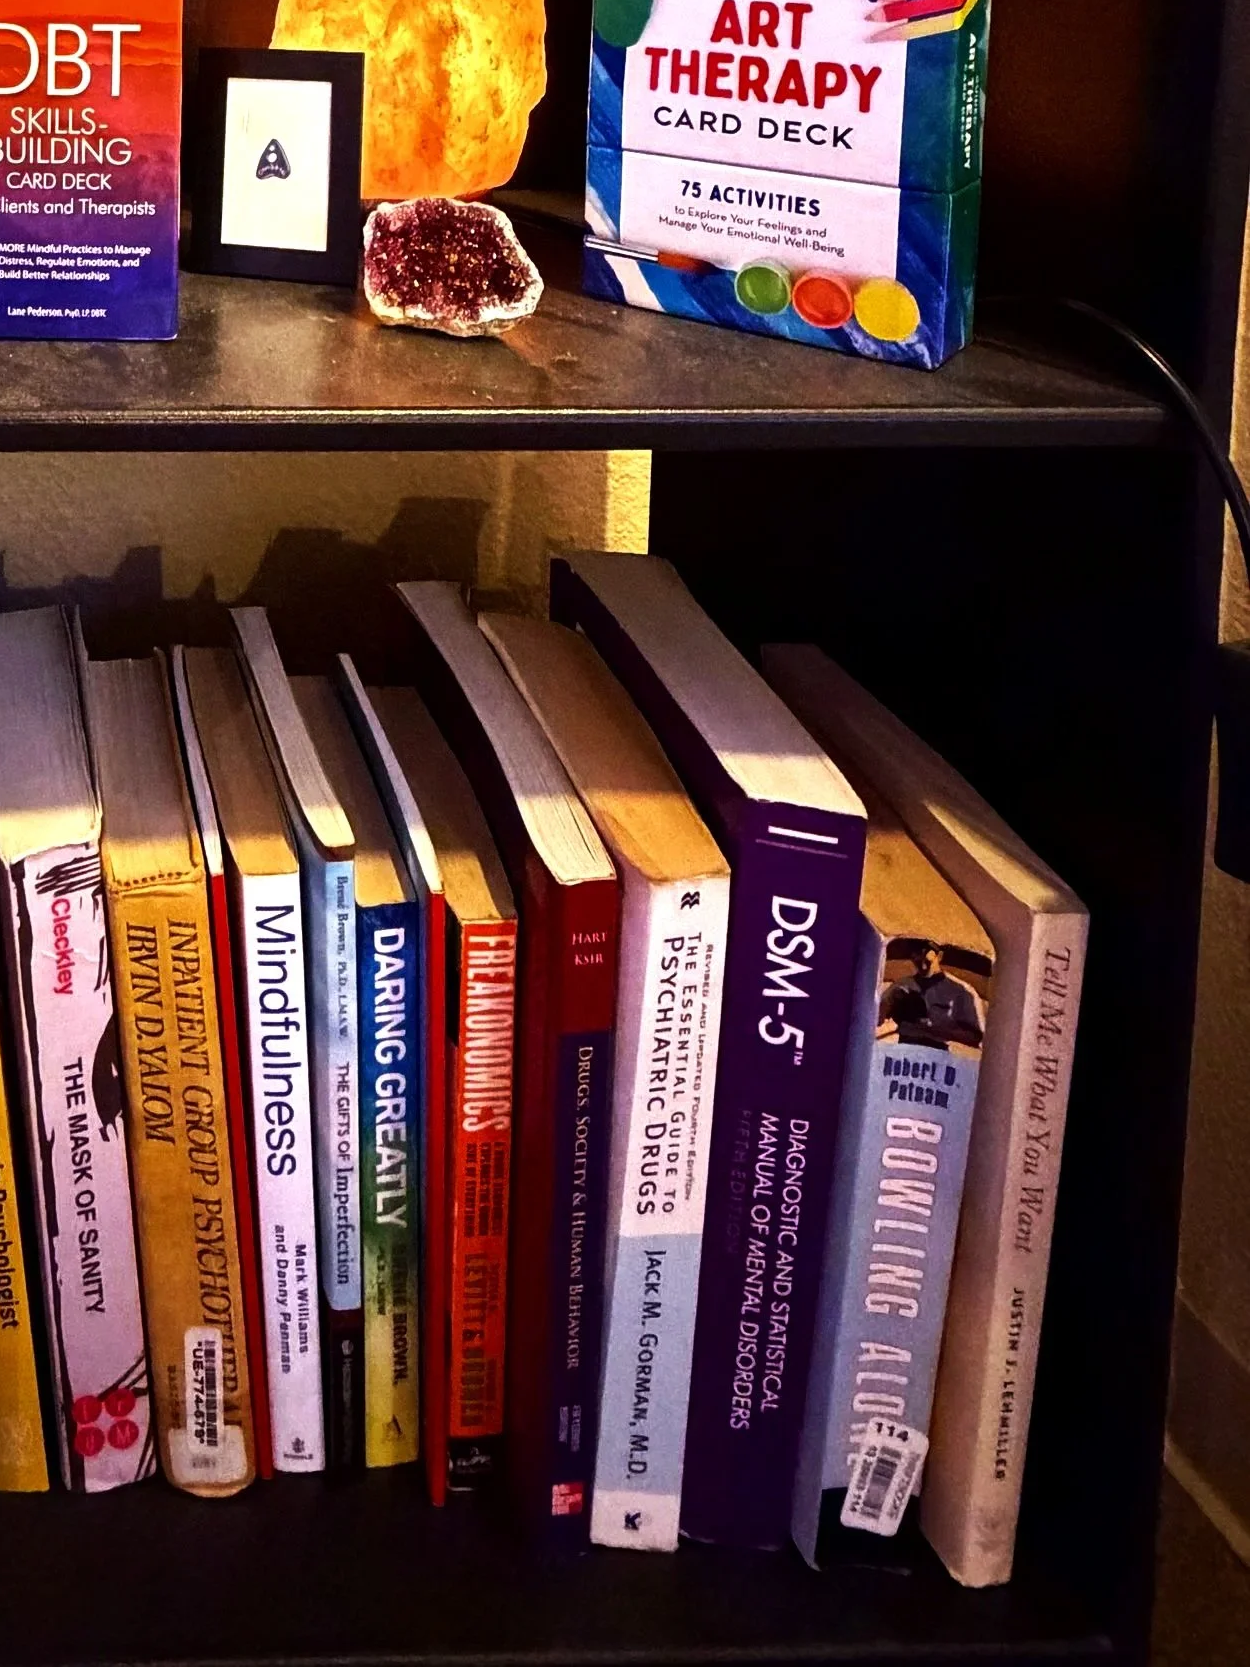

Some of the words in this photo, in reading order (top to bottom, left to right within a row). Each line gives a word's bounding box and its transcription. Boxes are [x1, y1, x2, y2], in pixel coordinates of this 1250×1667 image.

[710, 0, 814, 50] ART
[645, 47, 883, 113] THERAPY
[10, 107, 108, 135] SKILLS-
[654, 106, 742, 135] CARD
[757, 117, 854, 150] DECK
[963, 75, 975, 170] THERAPY
[6, 172, 57, 190] CARD
[62, 173, 112, 190] DECK
[43, 198, 74, 215] and
[78, 200, 156, 219] Therapists
[680, 179, 702, 199] 75
[708, 185, 822, 217] ACTIVITIES
[26, 243, 61, 254] Mindful
[62, 244, 103, 255] Practices
[103, 245, 113, 255] to
[114, 244, 151, 257] Manage
[658, 214, 698, 231] Manage
[701, 222, 724, 235] Your
[727, 227, 781, 245] Emotional
[675, 205, 686, 216] to
[688, 208, 727, 223] Explore
[730, 215, 754, 228] Your
[757, 219, 803, 236] Feelings
[805, 226, 828, 239] and
[22, 270, 49, 280] Better
[50, 272, 110, 282] Relationships
[35, 258, 76, 270] Regulate
[121, 259, 140, 268] and
[7, 306, 26, 317] Lane
[51, 898, 76, 995] Cleckley
[127, 922, 164, 1010] IRVIN
[572, 932, 607, 944] HART
[574, 953, 604, 966] KSIR
[684, 933, 702, 971] THE
[167, 918, 211, 1076] INPATIENT
[374, 927, 406, 1065] DARING
[1042, 947, 1071, 998] Tell
[134, 1013, 165, 1041] D.
[255, 904, 301, 1176] Mindfulness
[462, 935, 516, 1132] FREAKONOMICS
[646, 936, 685, 1112] PSYCHIATRIC
[672, 985, 697, 1100] ESSENTIAL
[1036, 1004, 1062, 1047] Me
[63, 1057, 87, 1110] THE
[138, 1046, 175, 1145] YALOM
[337, 1062, 350, 1093] THE
[883, 1055, 937, 1083] Robert
[888, 1080, 949, 1109] Putnam
[1029, 1056, 1059, 1121] What
[182, 1086, 221, 1186] GROUP
[337, 1096, 350, 1138] GIFTS
[664, 1111, 686, 1177] GUIDE
[67, 1114, 94, 1185] MASK
[338, 1141, 350, 1161] OF
[375, 1072, 408, 1229] GREATLY
[573, 1116, 591, 1185] SOCIETY
[636, 1122, 667, 1216] DRUGS
[753, 1112, 780, 1198] MANUAL
[1023, 1129, 1049, 1176] You
[75, 1190, 98, 1224] OF
[662, 1186, 677, 1214] TO
[777, 1118, 809, 1247] DIAGNOSTIC
[275, 1225, 287, 1254] and
[334, 1166, 355, 1285] Imperfection
[569, 1212, 587, 1279] HUMAN
[750, 1204, 771, 1236] OF
[865, 1117, 943, 1318] BOWLING
[1014, 1186, 1045, 1255] Want
[78, 1230, 105, 1314] SANITY
[275, 1258, 289, 1307] Danny
[295, 1244, 308, 1283] Mark
[644, 1249, 667, 1295] JACK
[741, 1237, 768, 1315] MENTAL
[772, 1249, 794, 1297] AND
[279, 1311, 291, 1374] Penman
[296, 1287, 310, 1353] Williams
[566, 1284, 584, 1370] BEHAVIOR
[1009, 1287, 1024, 1351] JUSTIN
[629, 1333, 659, 1427] GORMAN,
[729, 1319, 760, 1431] DISORDERS
[760, 1300, 791, 1413] STATISTICAL
[875, 1421, 910, 1442] 114
[995, 1380, 1015, 1479] LEHMILLER
